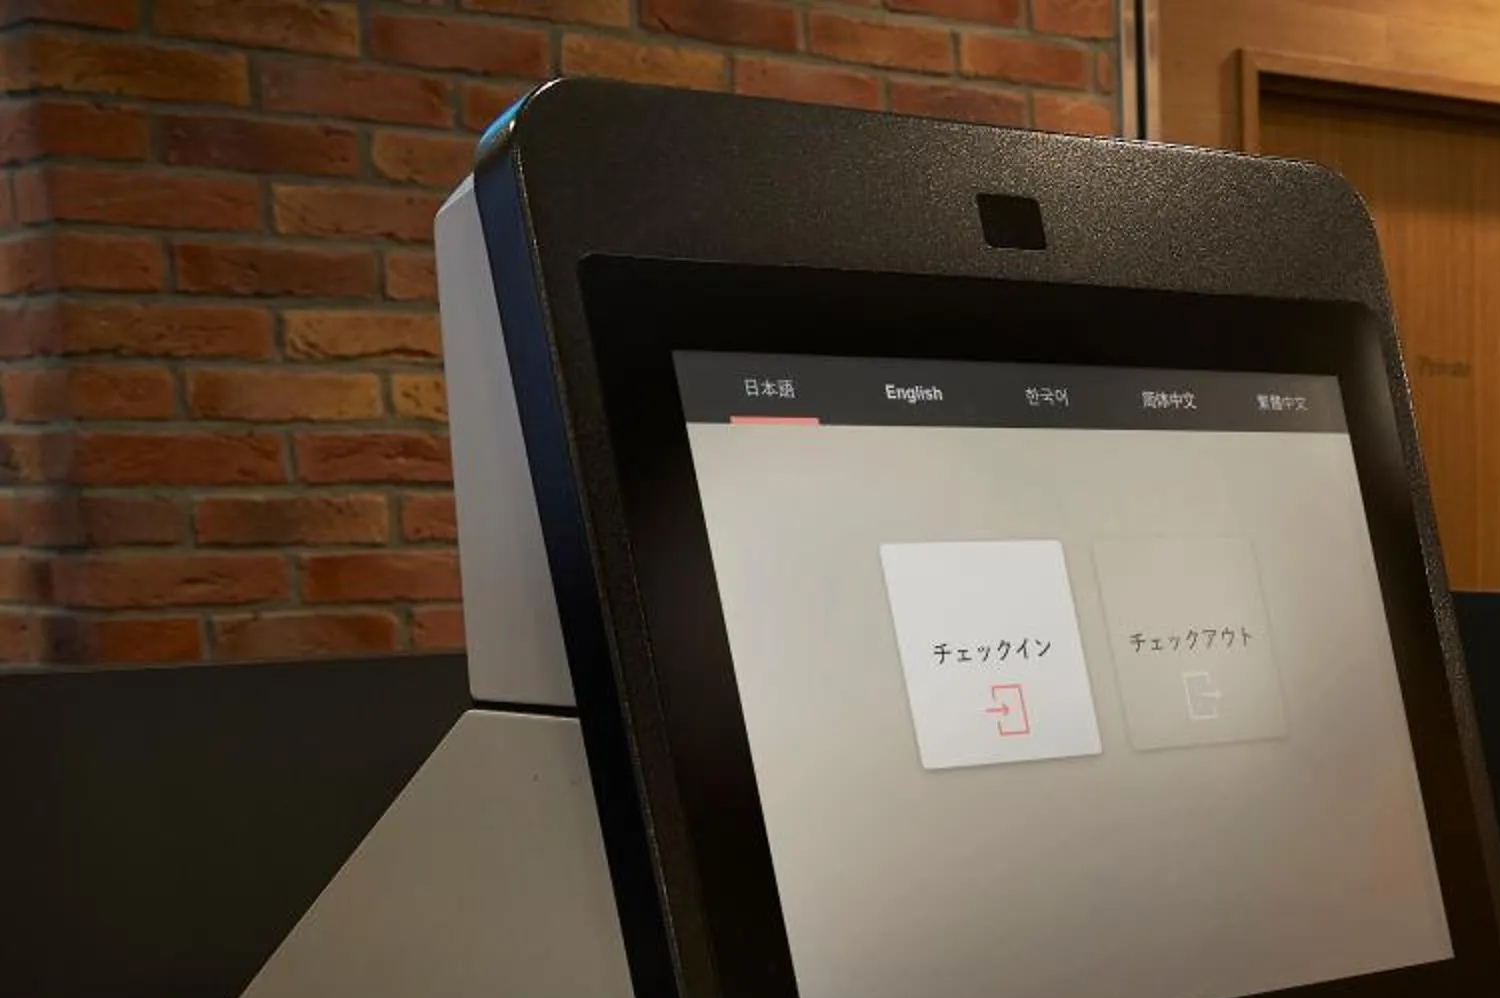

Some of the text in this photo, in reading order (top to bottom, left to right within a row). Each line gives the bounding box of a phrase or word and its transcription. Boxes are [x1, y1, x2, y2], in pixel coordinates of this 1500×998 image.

[743, 378, 796, 399] 日本語
[885, 383, 943, 404] English
[1025, 386, 1070, 407] 한국어
[1129, 626, 1253, 653] チェックアウト
[932, 637, 1052, 665] チェックイン
